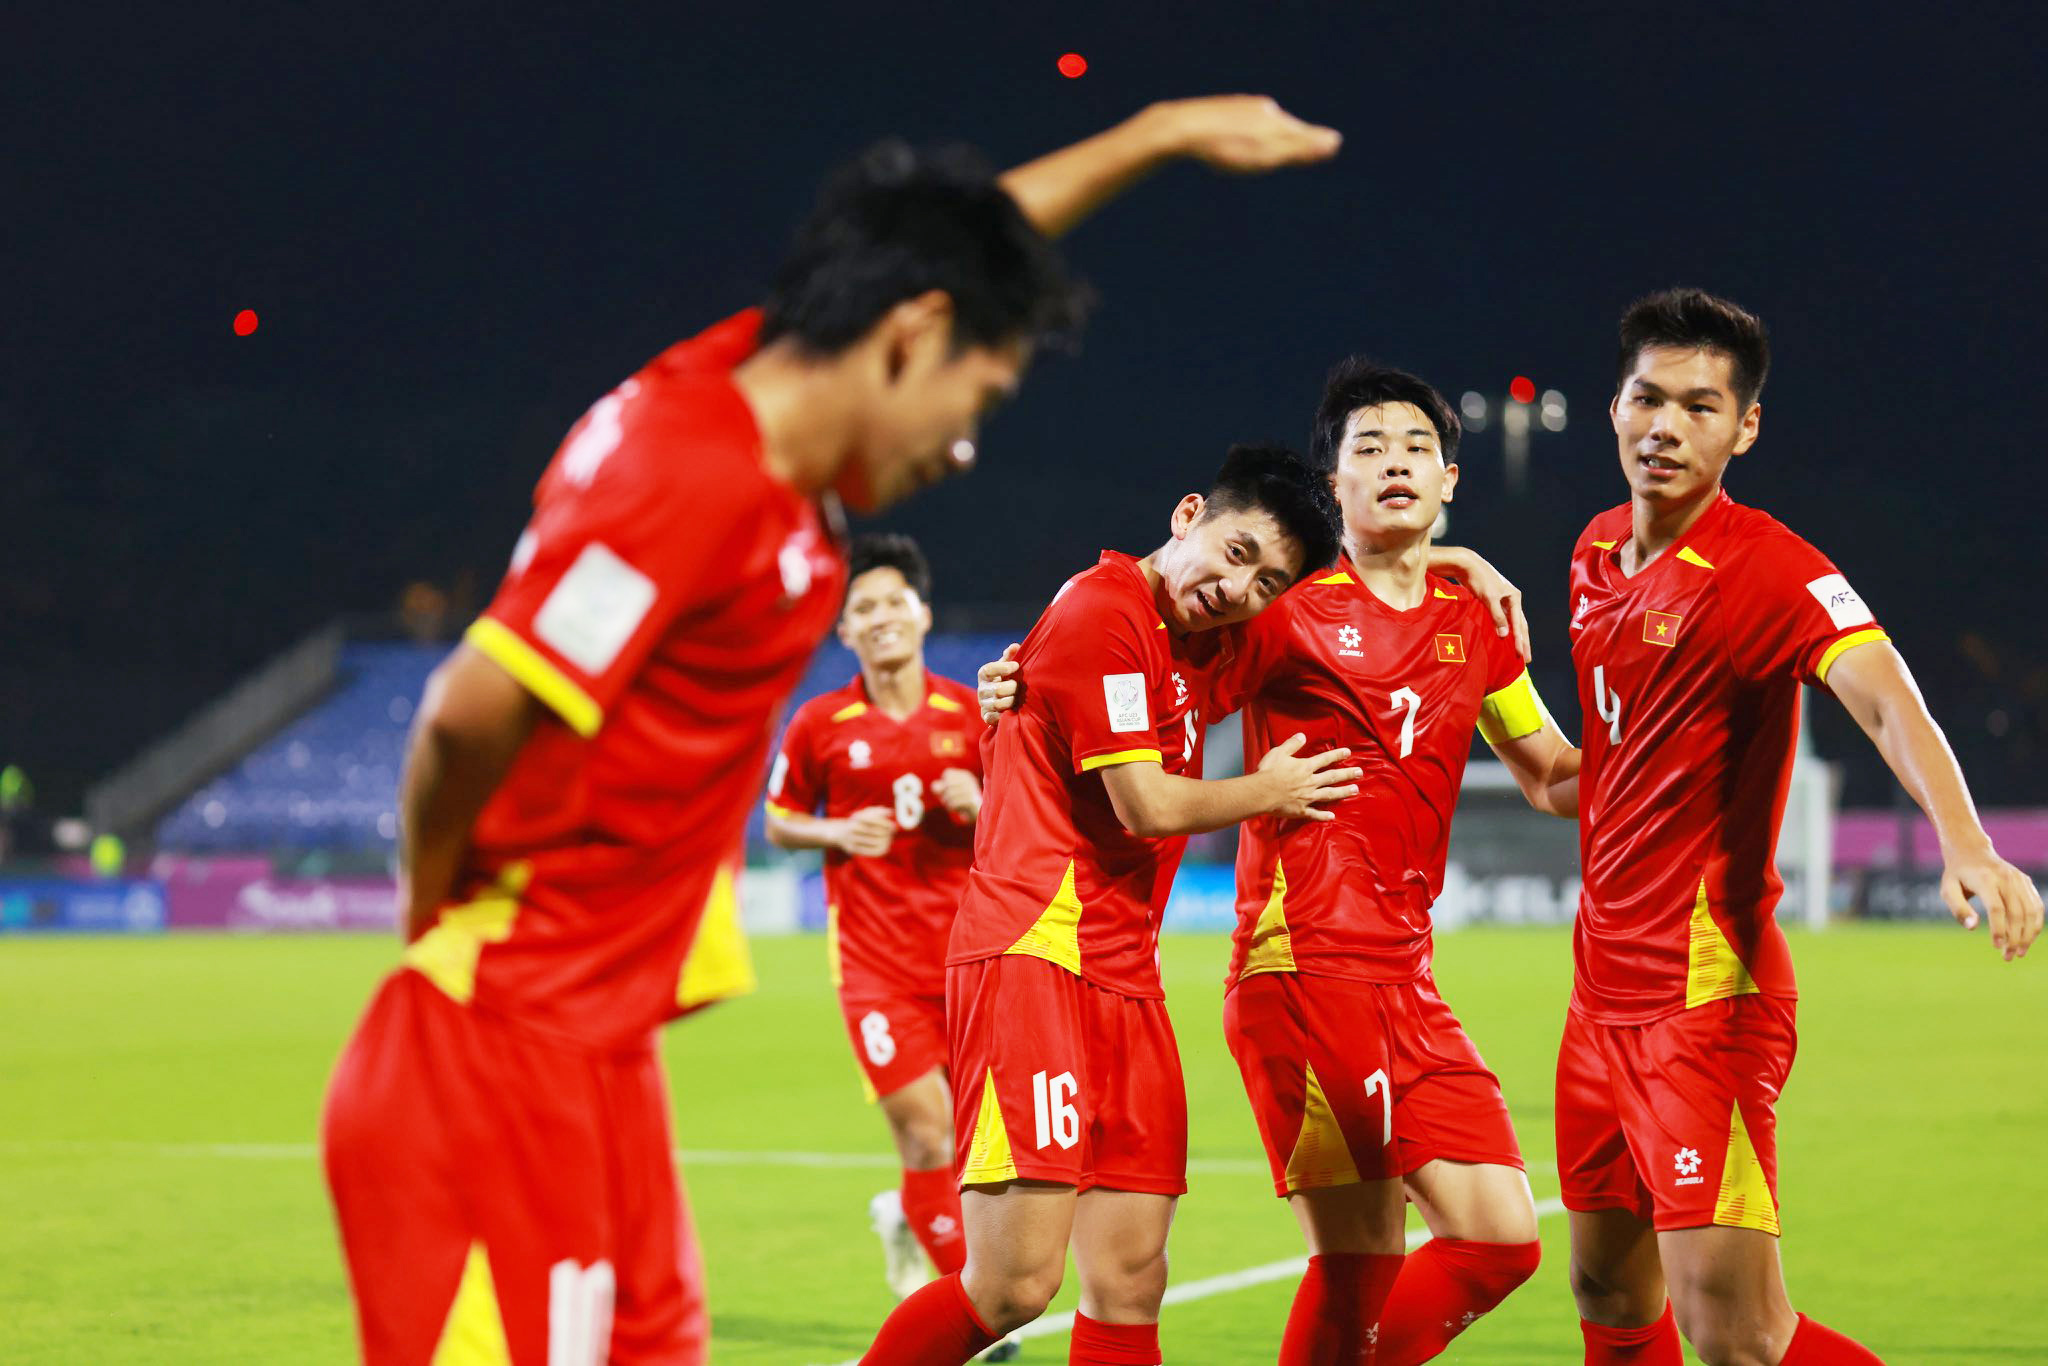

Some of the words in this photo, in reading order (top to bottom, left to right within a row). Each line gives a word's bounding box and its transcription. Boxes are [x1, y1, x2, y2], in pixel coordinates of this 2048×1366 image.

[1831, 591, 1855, 607] AFC
[1390, 686, 1421, 759] 7
[1594, 665, 1622, 745] 4
[893, 773, 924, 829] 8
[860, 1011, 896, 1067] 8
[1033, 1070, 1079, 1150] 16
[1364, 1068, 1391, 1146] 7
